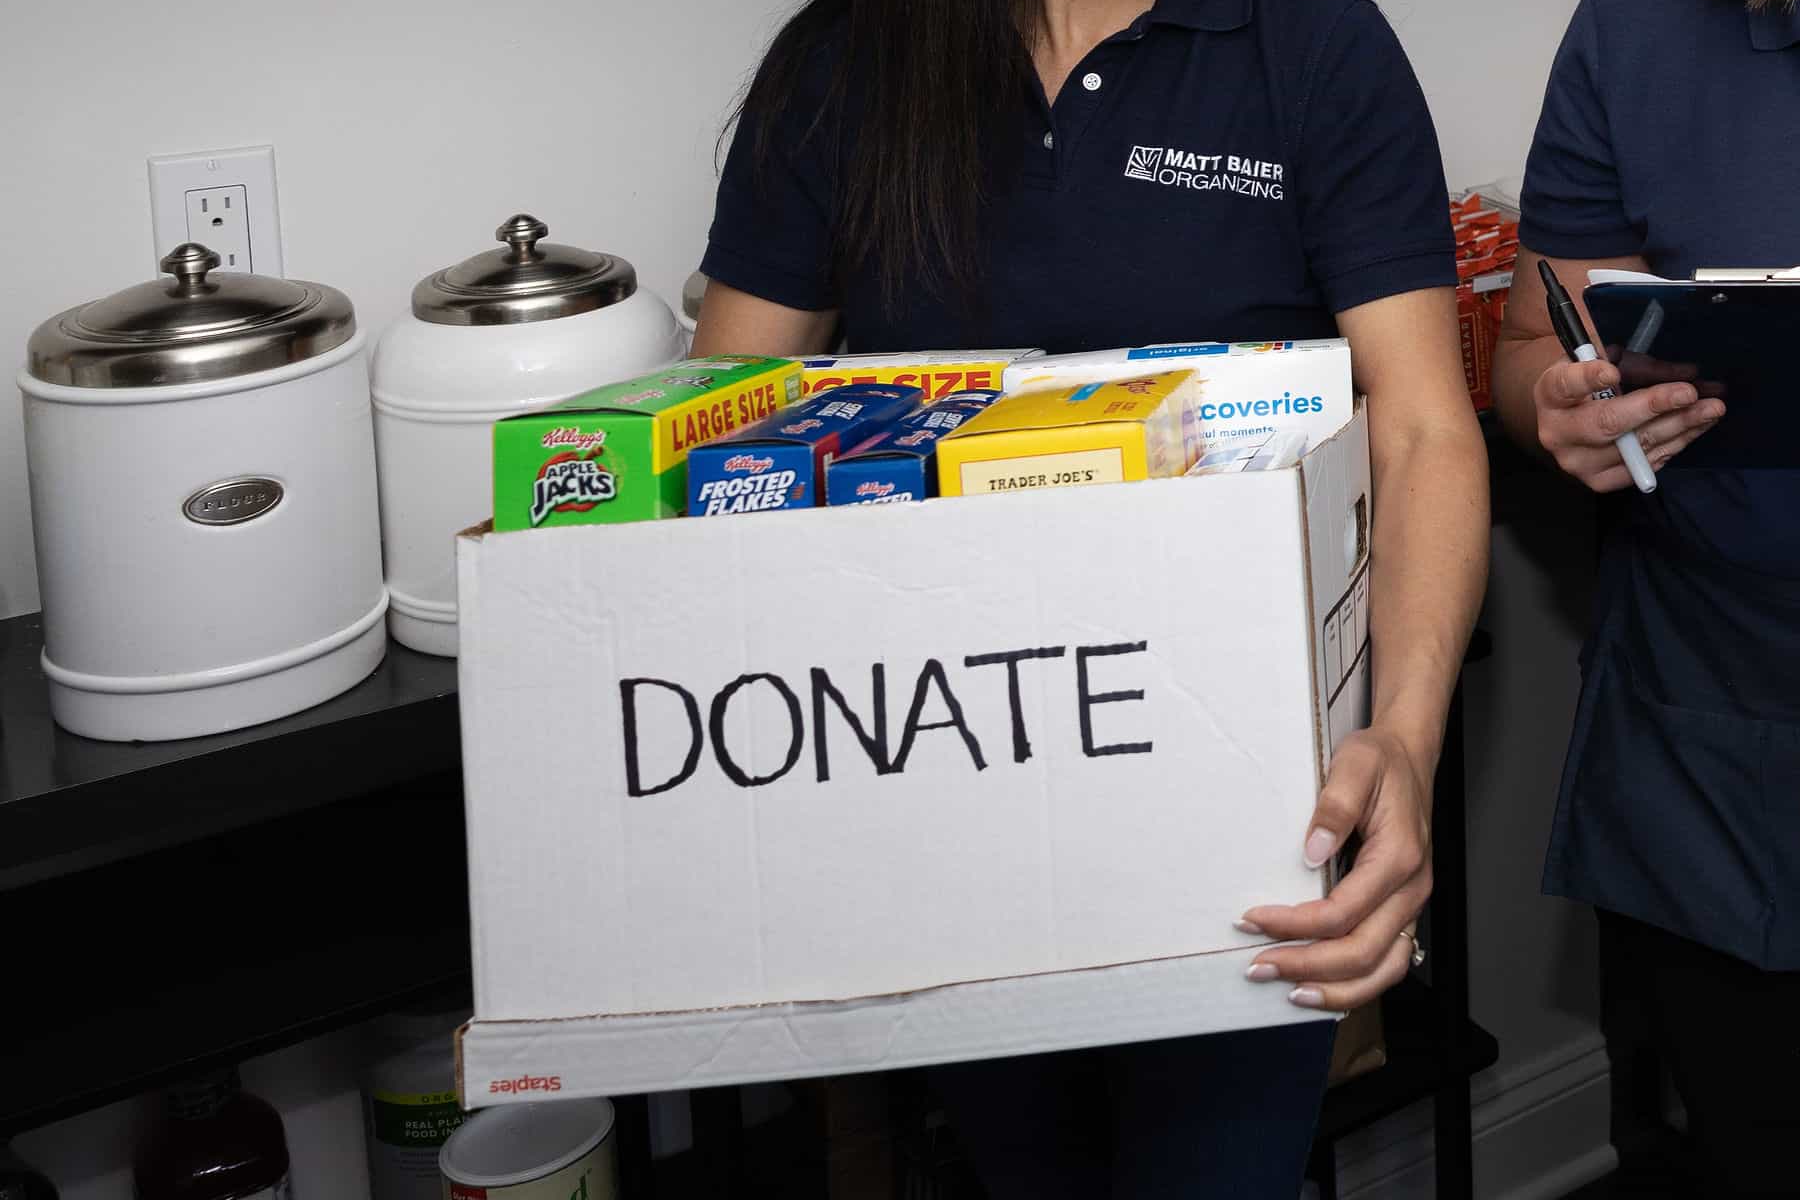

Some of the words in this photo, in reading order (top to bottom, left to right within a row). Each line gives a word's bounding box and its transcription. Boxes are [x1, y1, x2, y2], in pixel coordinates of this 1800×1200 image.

[1164, 148, 1222, 171] MATT
[1227, 155, 1284, 182] BAIER
[1158, 168, 1284, 201] ORGANIZING
[672, 411, 734, 452] LARGE
[740, 383, 777, 424] SIZE
[1200, 391, 1324, 421] coveries
[542, 428, 605, 449] Kellogg's
[1219, 426, 1278, 438] moments.
[546, 462, 596, 479] APPLE
[724, 455, 774, 471] Kellogg's
[698, 470, 796, 502] FROSTED
[856, 482, 895, 496] Kellogg's
[989, 472, 1048, 492] TRADER
[1052, 469, 1094, 486] JOE'S
[530, 473, 618, 527] JACKS
[704, 492, 787, 517] FLAKES
[619, 639, 1154, 799] DONATE
[487, 1074, 563, 1096] Staples
[404, 1121, 433, 1129] REAL
[405, 1129, 437, 1138] FOOD
